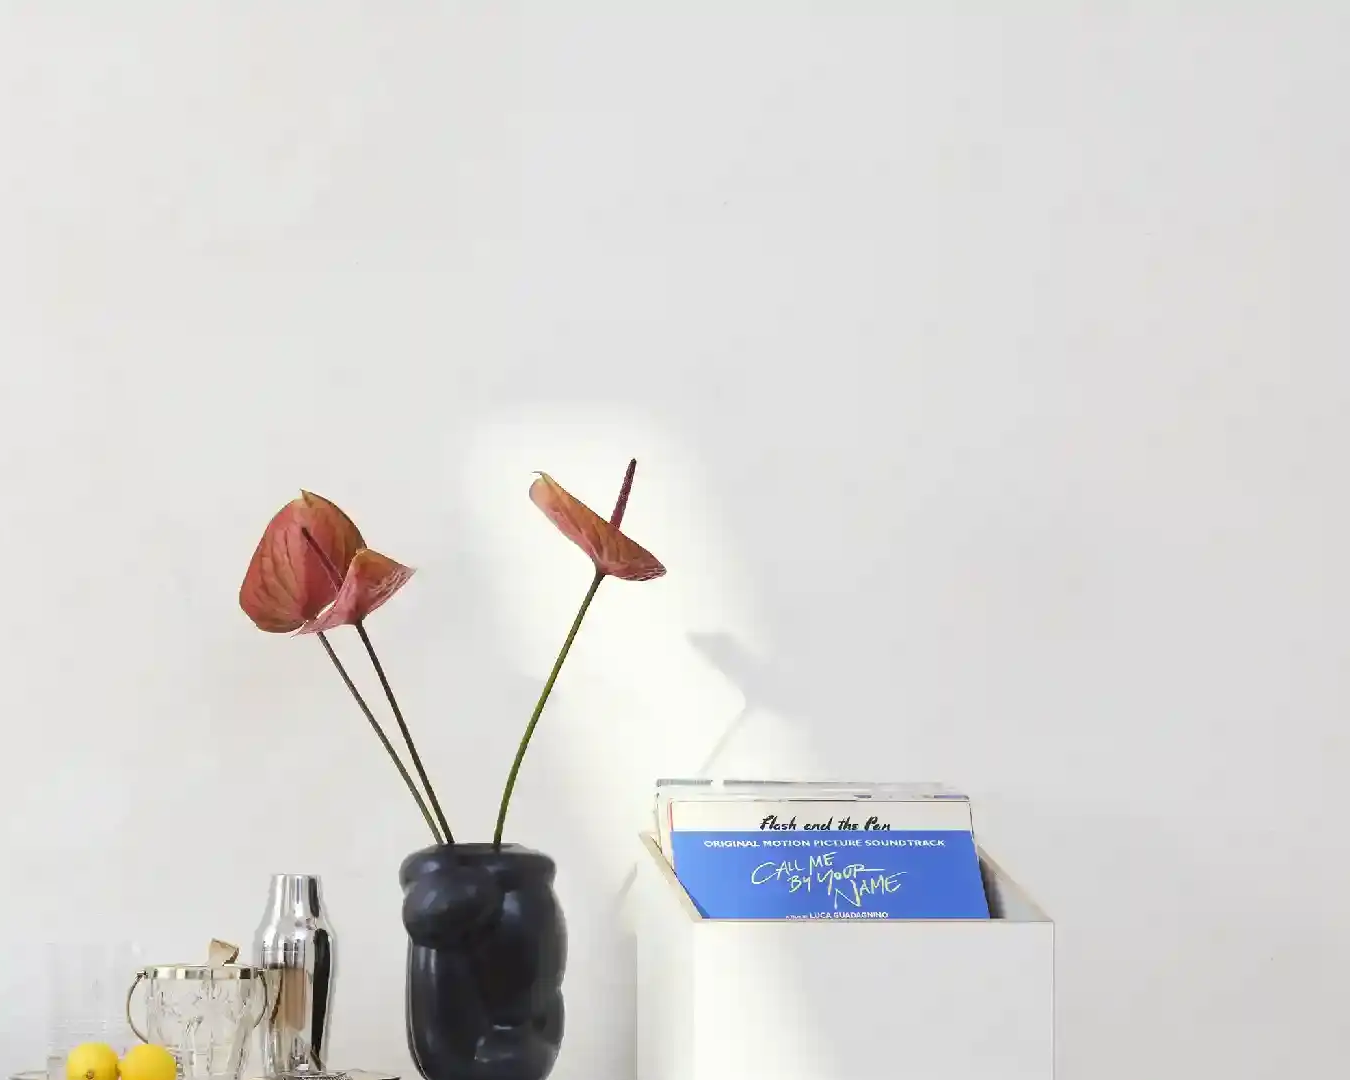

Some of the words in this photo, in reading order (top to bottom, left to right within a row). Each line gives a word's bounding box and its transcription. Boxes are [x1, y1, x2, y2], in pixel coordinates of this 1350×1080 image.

[759, 814, 797, 831] Flash
[803, 815, 831, 831] and
[837, 816, 859, 831] the
[703, 839, 760, 848] ORIGINAL
[762, 839, 811, 848] MOTION
[813, 839, 863, 848] PICTURE
[864, 839, 946, 848] SOUNDTRACK
[751, 859, 805, 885] CALL
[809, 851, 837, 875] ME
[787, 874, 812, 893] BY
[817, 864, 885, 896] YOUR
[833, 871, 908, 909] NAME
[809, 911, 832, 919] LUCA
[833, 911, 889, 919] GUADAGNINO
